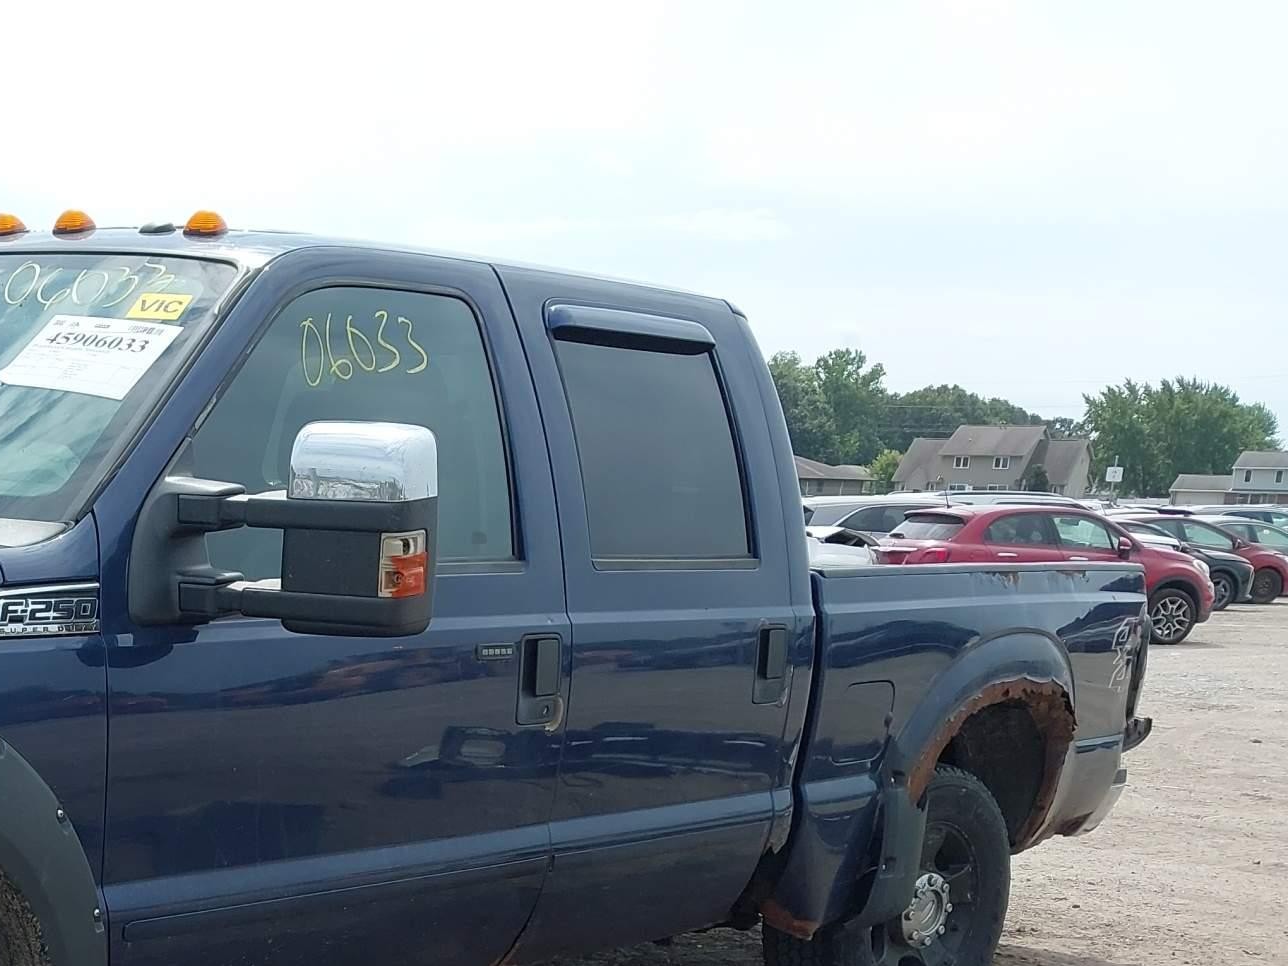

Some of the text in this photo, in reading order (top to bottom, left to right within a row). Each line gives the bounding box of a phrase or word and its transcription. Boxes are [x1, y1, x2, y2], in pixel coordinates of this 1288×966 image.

[4, 261, 176, 311] 06033
[140, 299, 184, 314] VIC
[45, 331, 150, 353] 45906033
[300, 310, 428, 386] 06033
[0, 626, 49, 635] SUPER
